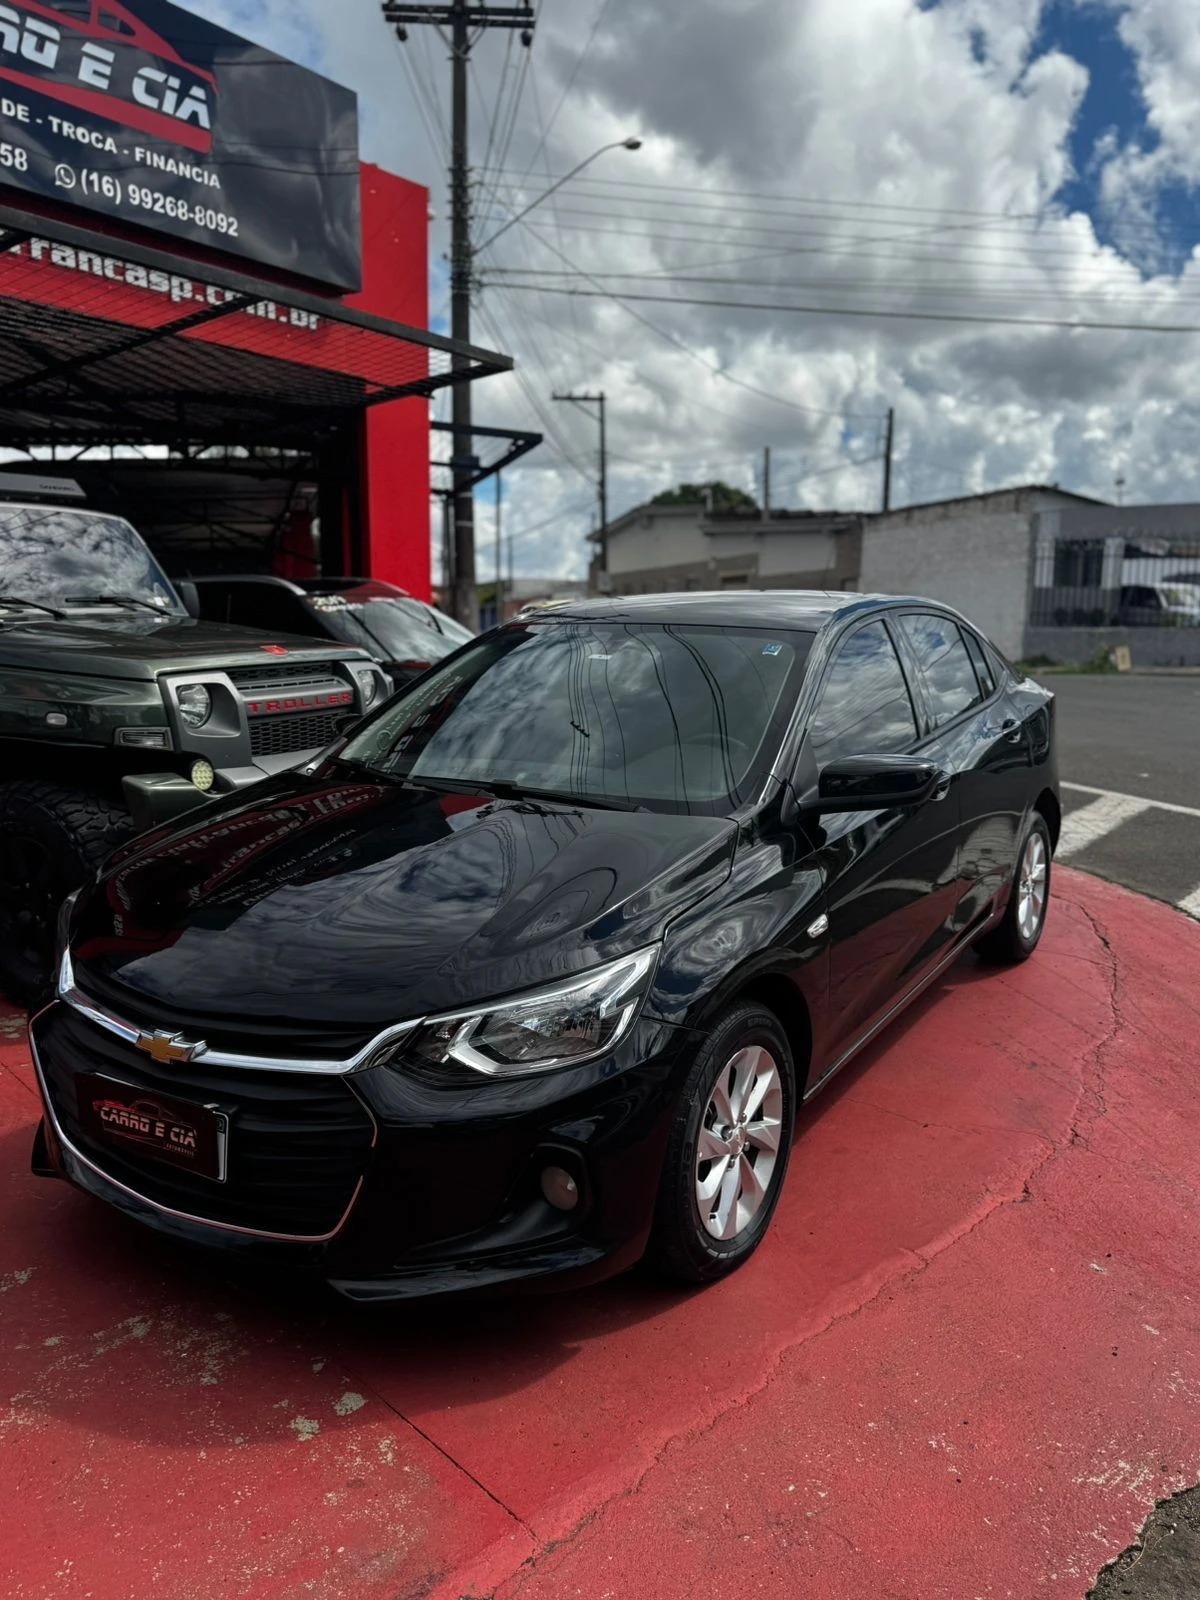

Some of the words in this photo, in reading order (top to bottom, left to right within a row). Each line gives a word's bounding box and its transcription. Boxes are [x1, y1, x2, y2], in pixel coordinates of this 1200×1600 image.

[78, 42, 115, 90] E
[48, 115, 118, 154] TROCA
[135, 146, 221, 189] FINANCIA
[81, 168, 122, 205] (16)
[127, 184, 239, 237] 99268-8092
[247, 692, 353, 715] TROLLER
[100, 1106, 150, 1133] CARRO
[155, 1122, 165, 1138] E
